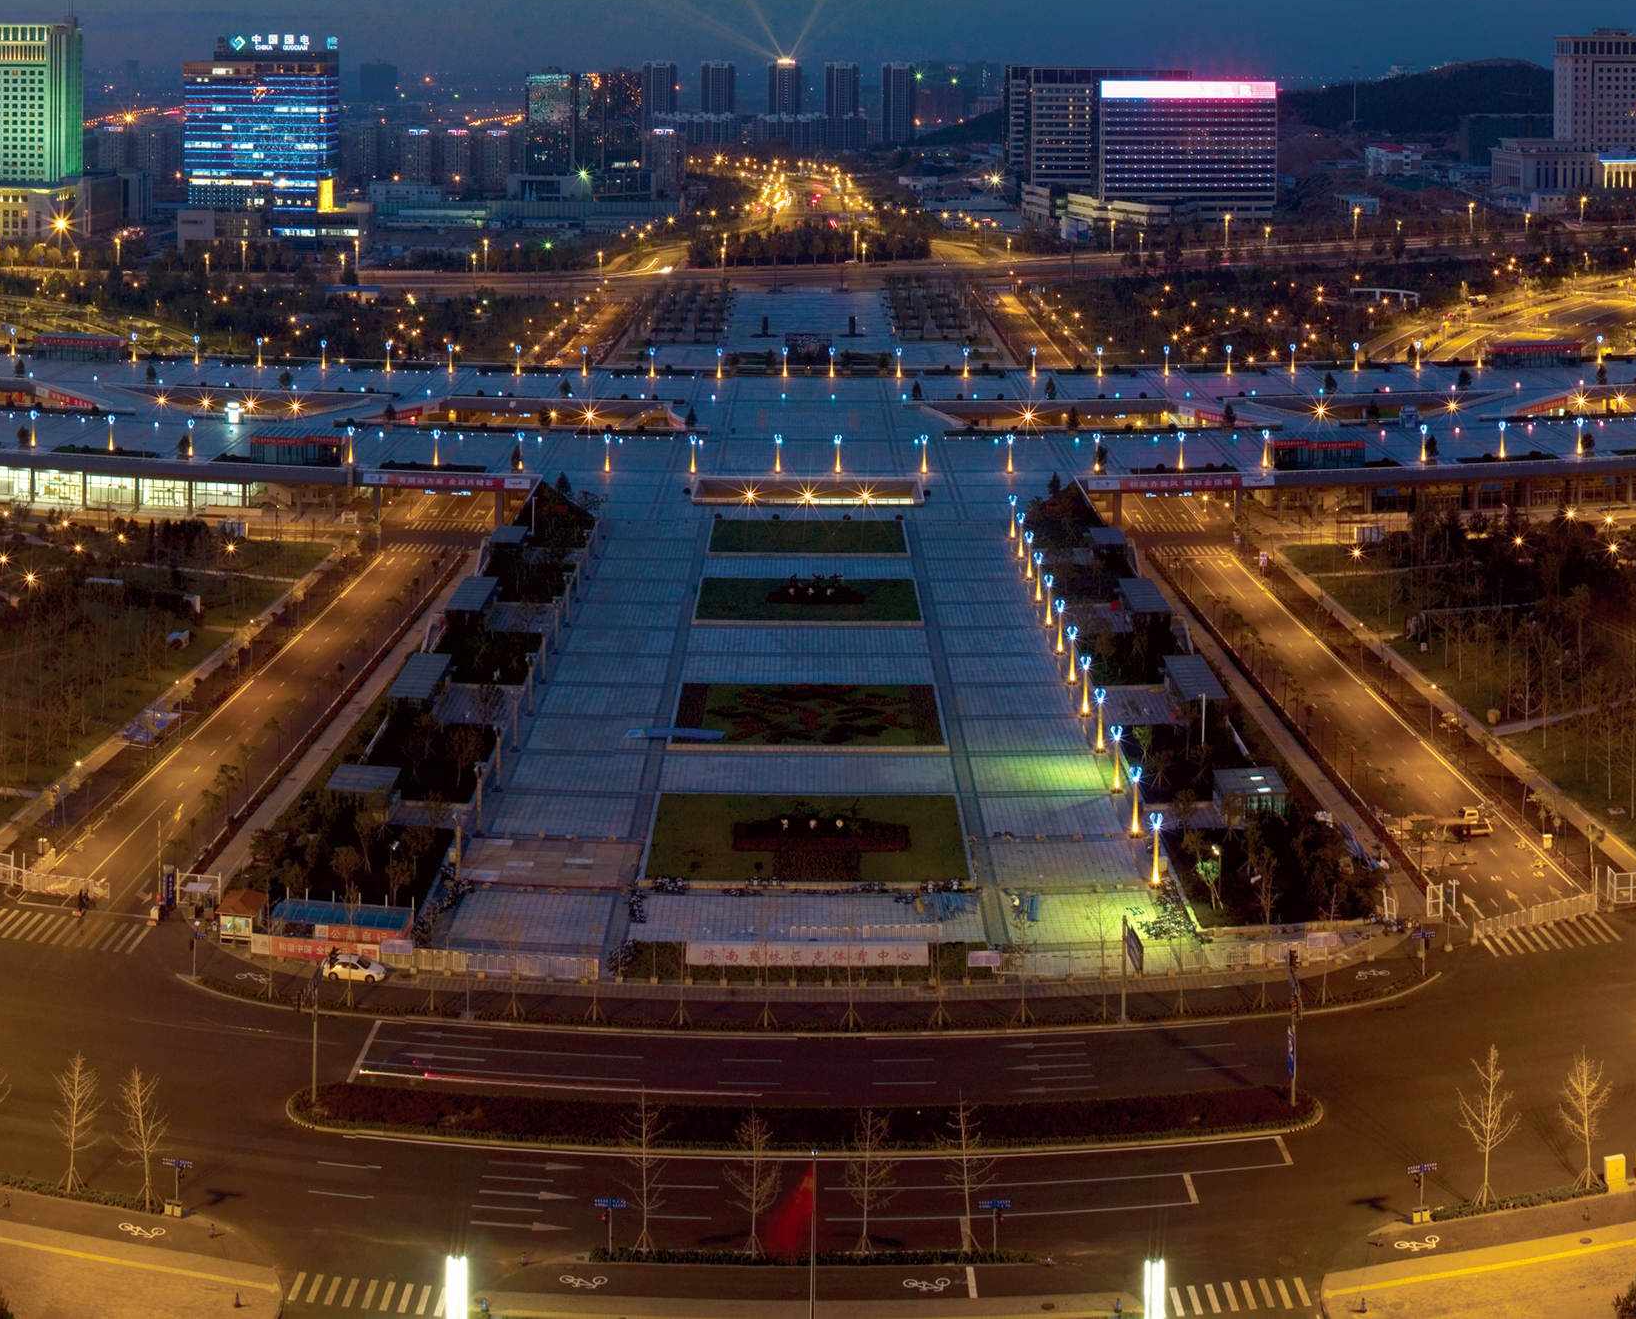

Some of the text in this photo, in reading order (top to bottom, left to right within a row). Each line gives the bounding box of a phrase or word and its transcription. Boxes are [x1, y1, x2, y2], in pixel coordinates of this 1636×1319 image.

[251, 34, 310, 45] 中国国电
[399, 476, 494, 487] 有朋远方来 全运共精彩
[1130, 478, 1232, 489] 和谐齐鲁风 精彩全运情
[278, 942, 313, 955] 和谐中国
[703, 948, 913, 965] 济南奥林匹克体育中心
